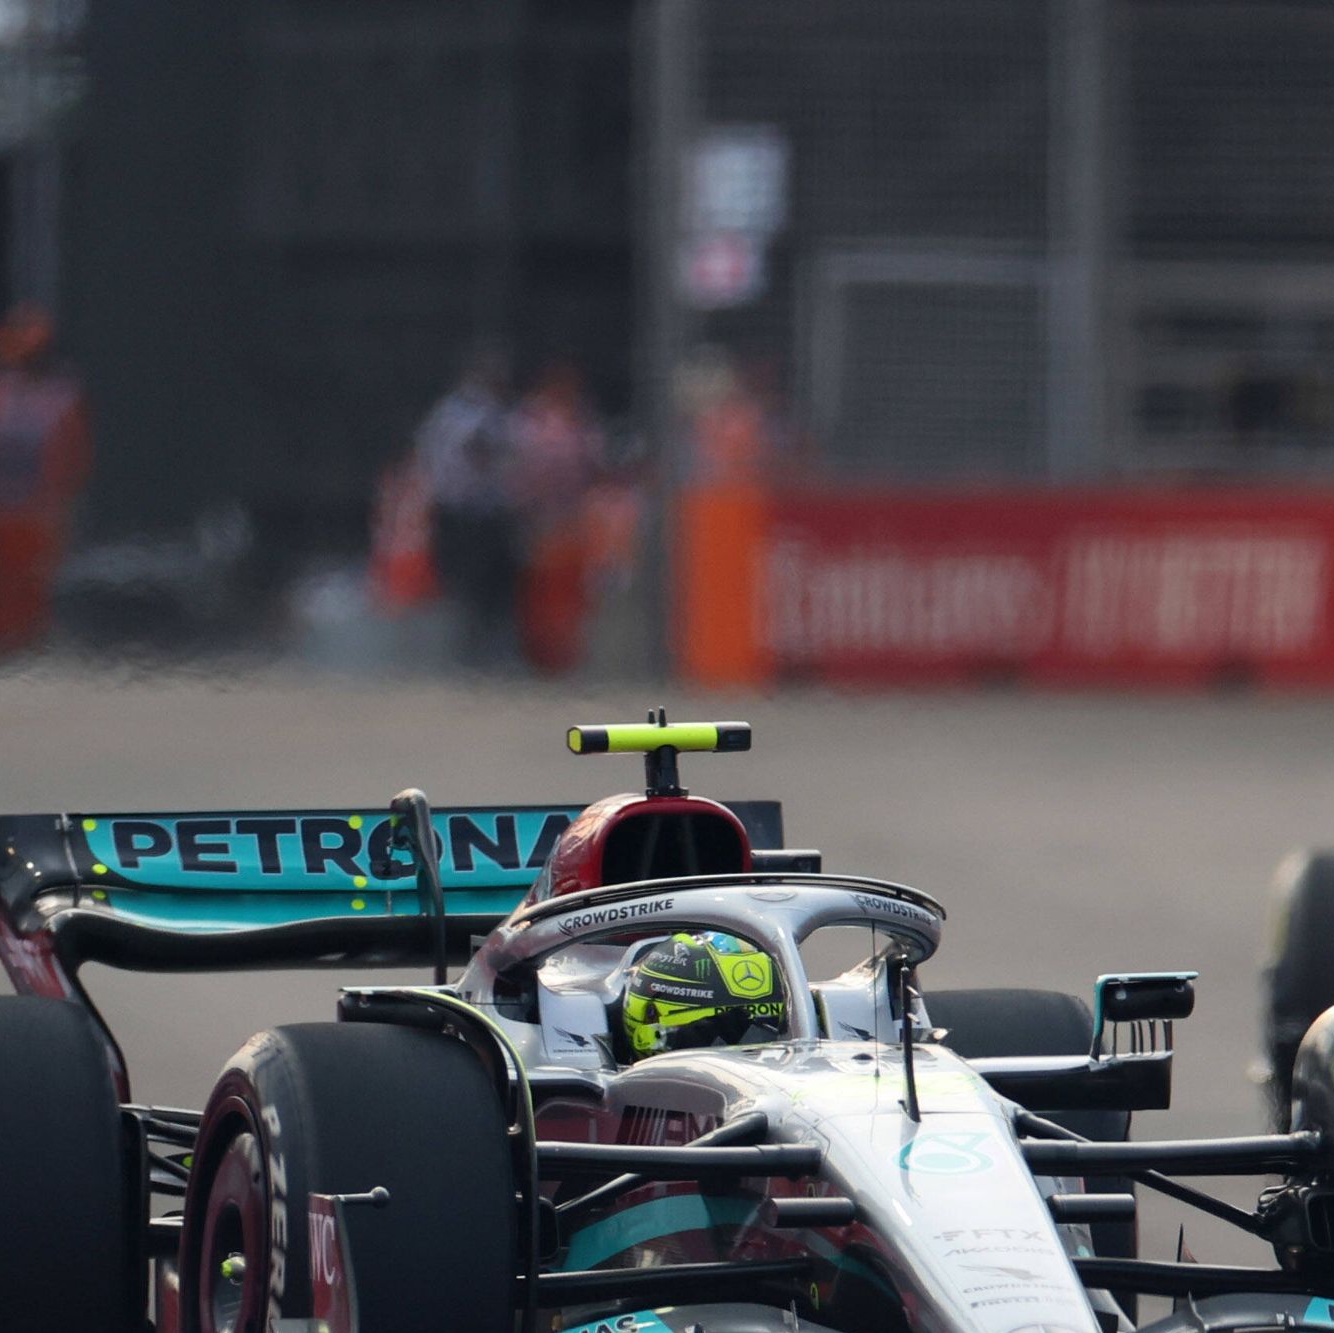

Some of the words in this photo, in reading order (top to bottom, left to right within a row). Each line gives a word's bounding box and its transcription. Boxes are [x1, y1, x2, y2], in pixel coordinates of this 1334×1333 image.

[564, 898, 675, 931] CROWDSTRIKE
[650, 983, 715, 999] CROWDSTRIKE
[715, 1003, 784, 1016] PRON
[970, 1228, 1044, 1242] FTX
